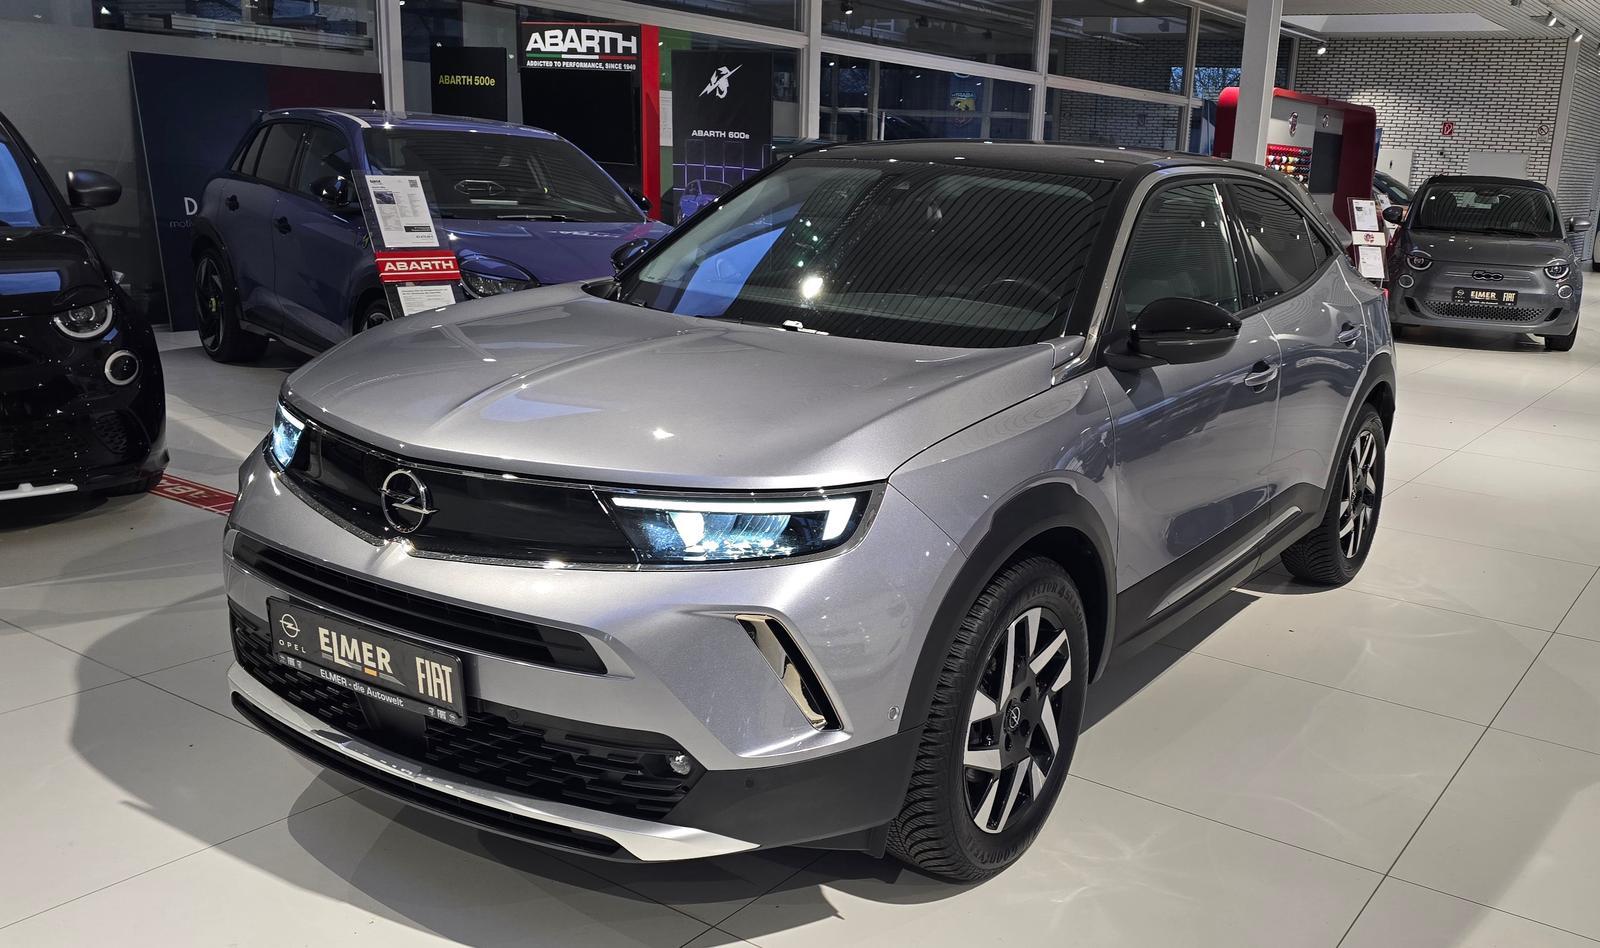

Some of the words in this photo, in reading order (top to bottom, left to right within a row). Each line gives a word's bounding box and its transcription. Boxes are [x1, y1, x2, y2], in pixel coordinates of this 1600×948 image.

[526, 28, 638, 54] ABARTH
[605, 62, 623, 70] SINCE
[438, 74, 473, 85] ABARTH
[474, 76, 496, 86] 500e
[691, 129, 726, 138] ABARTH
[728, 131, 750, 140] 600e
[384, 260, 454, 272] ABARTH
[1470, 290, 1497, 300] ELMER
[1502, 292, 1516, 302] FIAT
[279, 639, 307, 654] OPEL
[318, 626, 393, 675] ELMER
[415, 656, 453, 704] FIAT
[319, 668, 348, 687] ELMER
[353, 681, 365, 693] die
[366, 687, 404, 707] Autowelt
